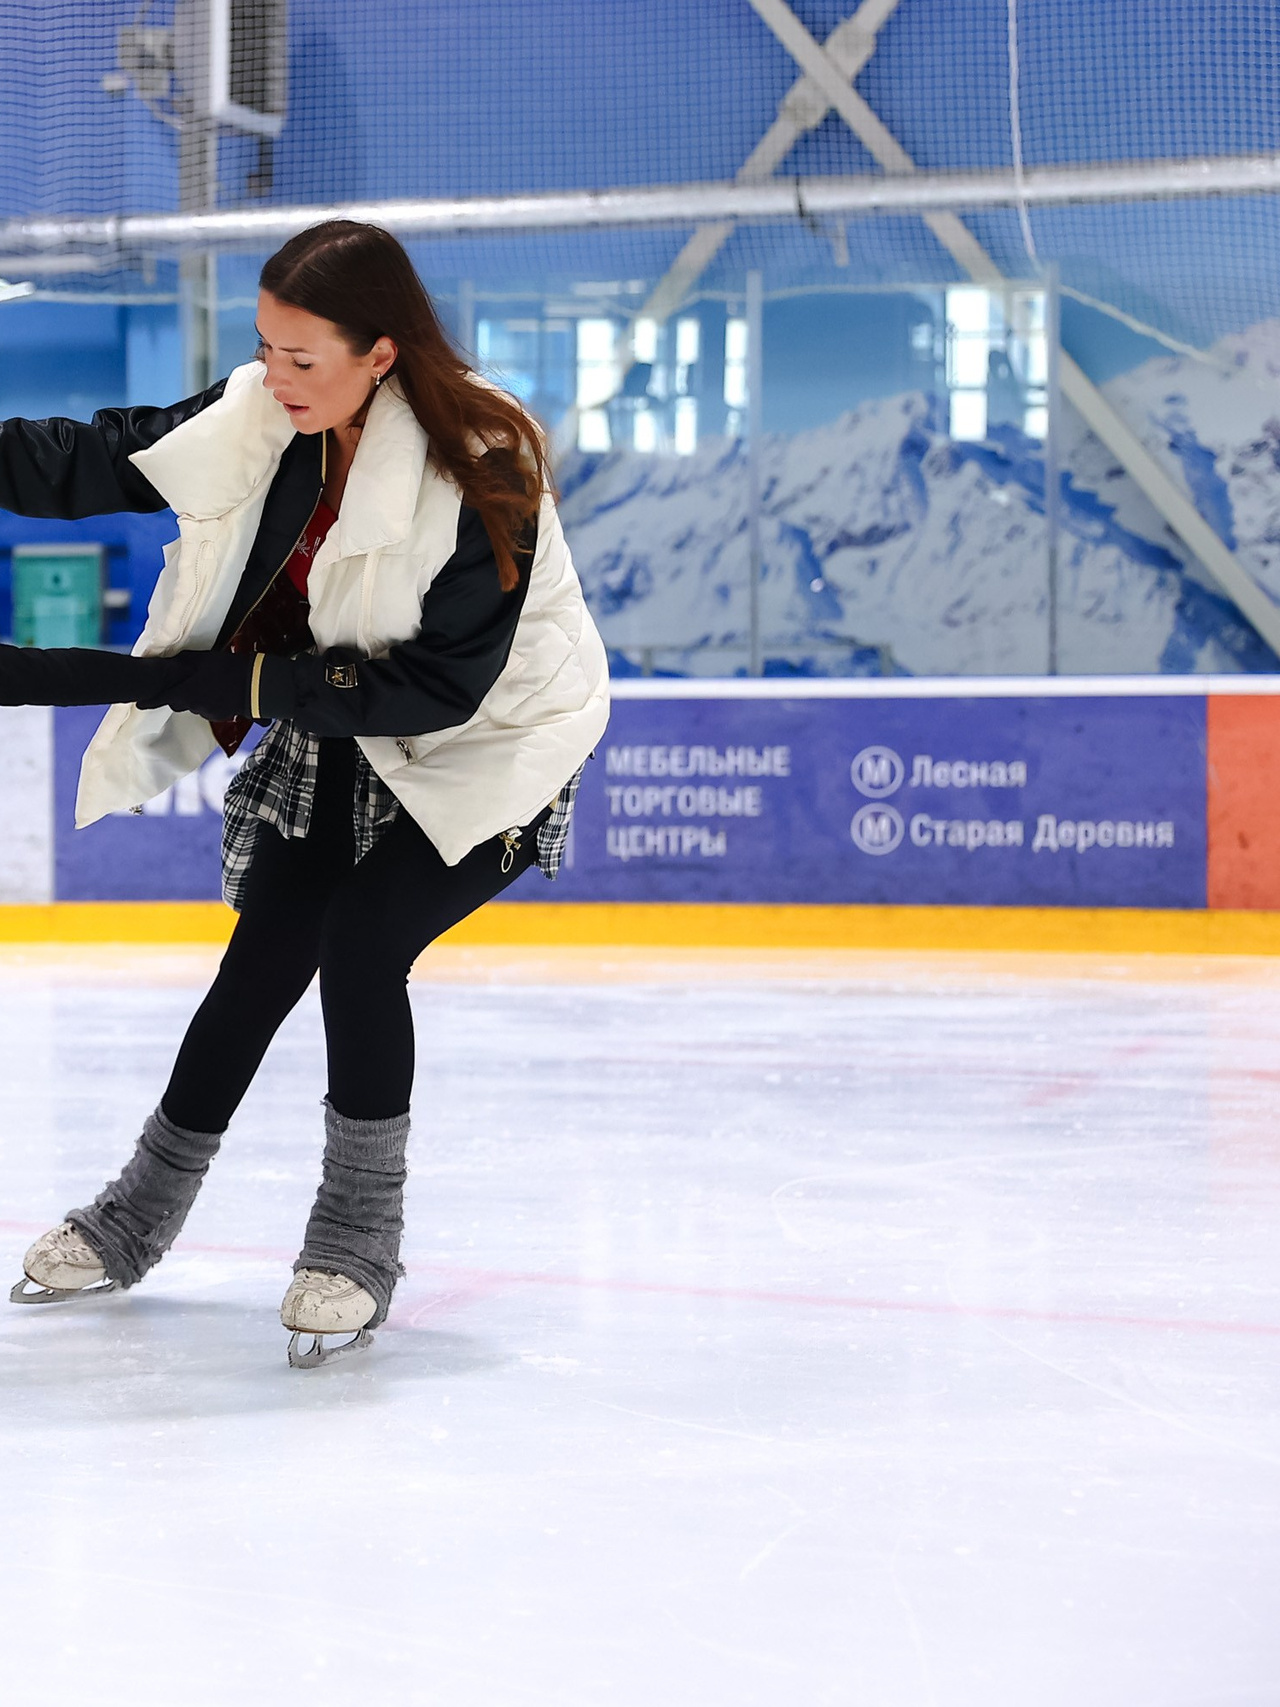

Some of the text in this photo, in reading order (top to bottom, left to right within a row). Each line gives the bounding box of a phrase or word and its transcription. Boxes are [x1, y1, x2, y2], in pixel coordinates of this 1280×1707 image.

[605, 745, 792, 777] МЕБЕЛЬНЫЕ
[908, 754, 1027, 788] Лесная
[605, 785, 763, 817] ТОРГОВЫЕ
[605, 825, 727, 861] ЦЕНТРЫ
[909, 812, 1025, 852] Старая
[1031, 813, 1175, 854] Деревня
